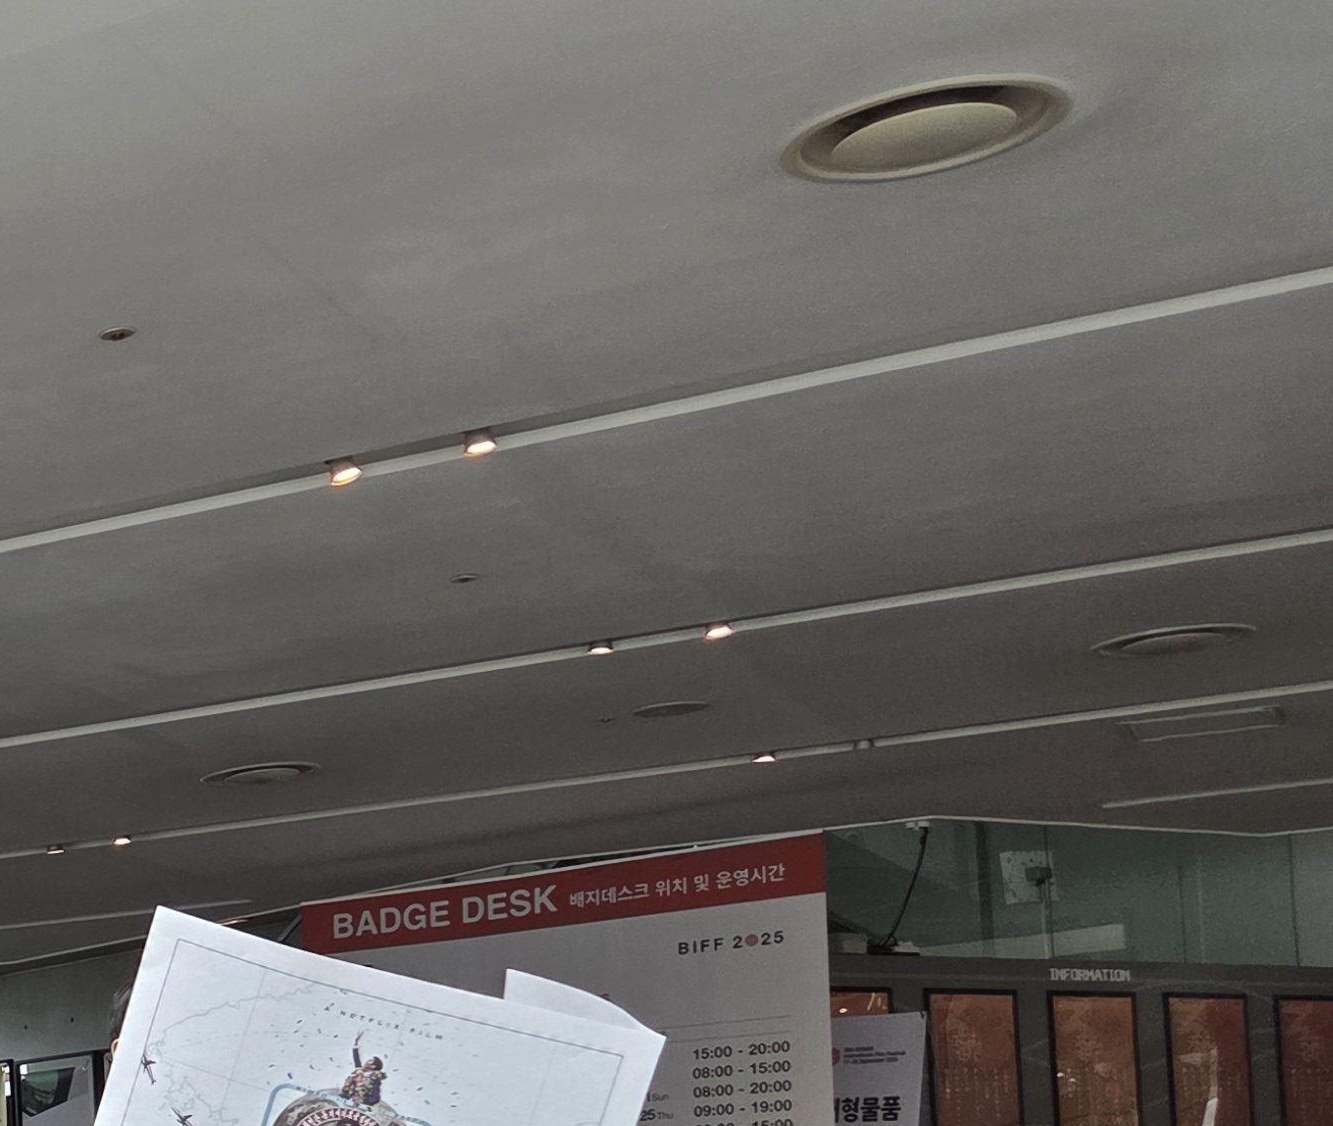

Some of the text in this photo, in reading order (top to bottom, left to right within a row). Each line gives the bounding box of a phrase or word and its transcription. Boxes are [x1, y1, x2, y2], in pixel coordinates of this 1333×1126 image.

[333, 863, 787, 940] BADGE DESK 배지데스크 위치 및 운영시간
[678, 937, 725, 956] BIFF
[1049, 967, 1131, 982] INFORMATION
[339, 1010, 401, 1030] NETFLIX
[409, 1027, 444, 1040] FILM
[692, 1045, 733, 1060] 15:00
[748, 1040, 791, 1056] 20:00
[692, 1065, 734, 1079] 08:00
[749, 1060, 791, 1074] 15:00
[651, 1092, 670, 1101] Sun
[693, 1084, 734, 1099] 08:00
[749, 1079, 792, 1095] 20:00
[639, 1109, 674, 1121] 25 Thu
[693, 1103, 735, 1117] 09:00
[751, 1099, 792, 1113] 19:00
[834, 1096, 902, 1123] 형물품
